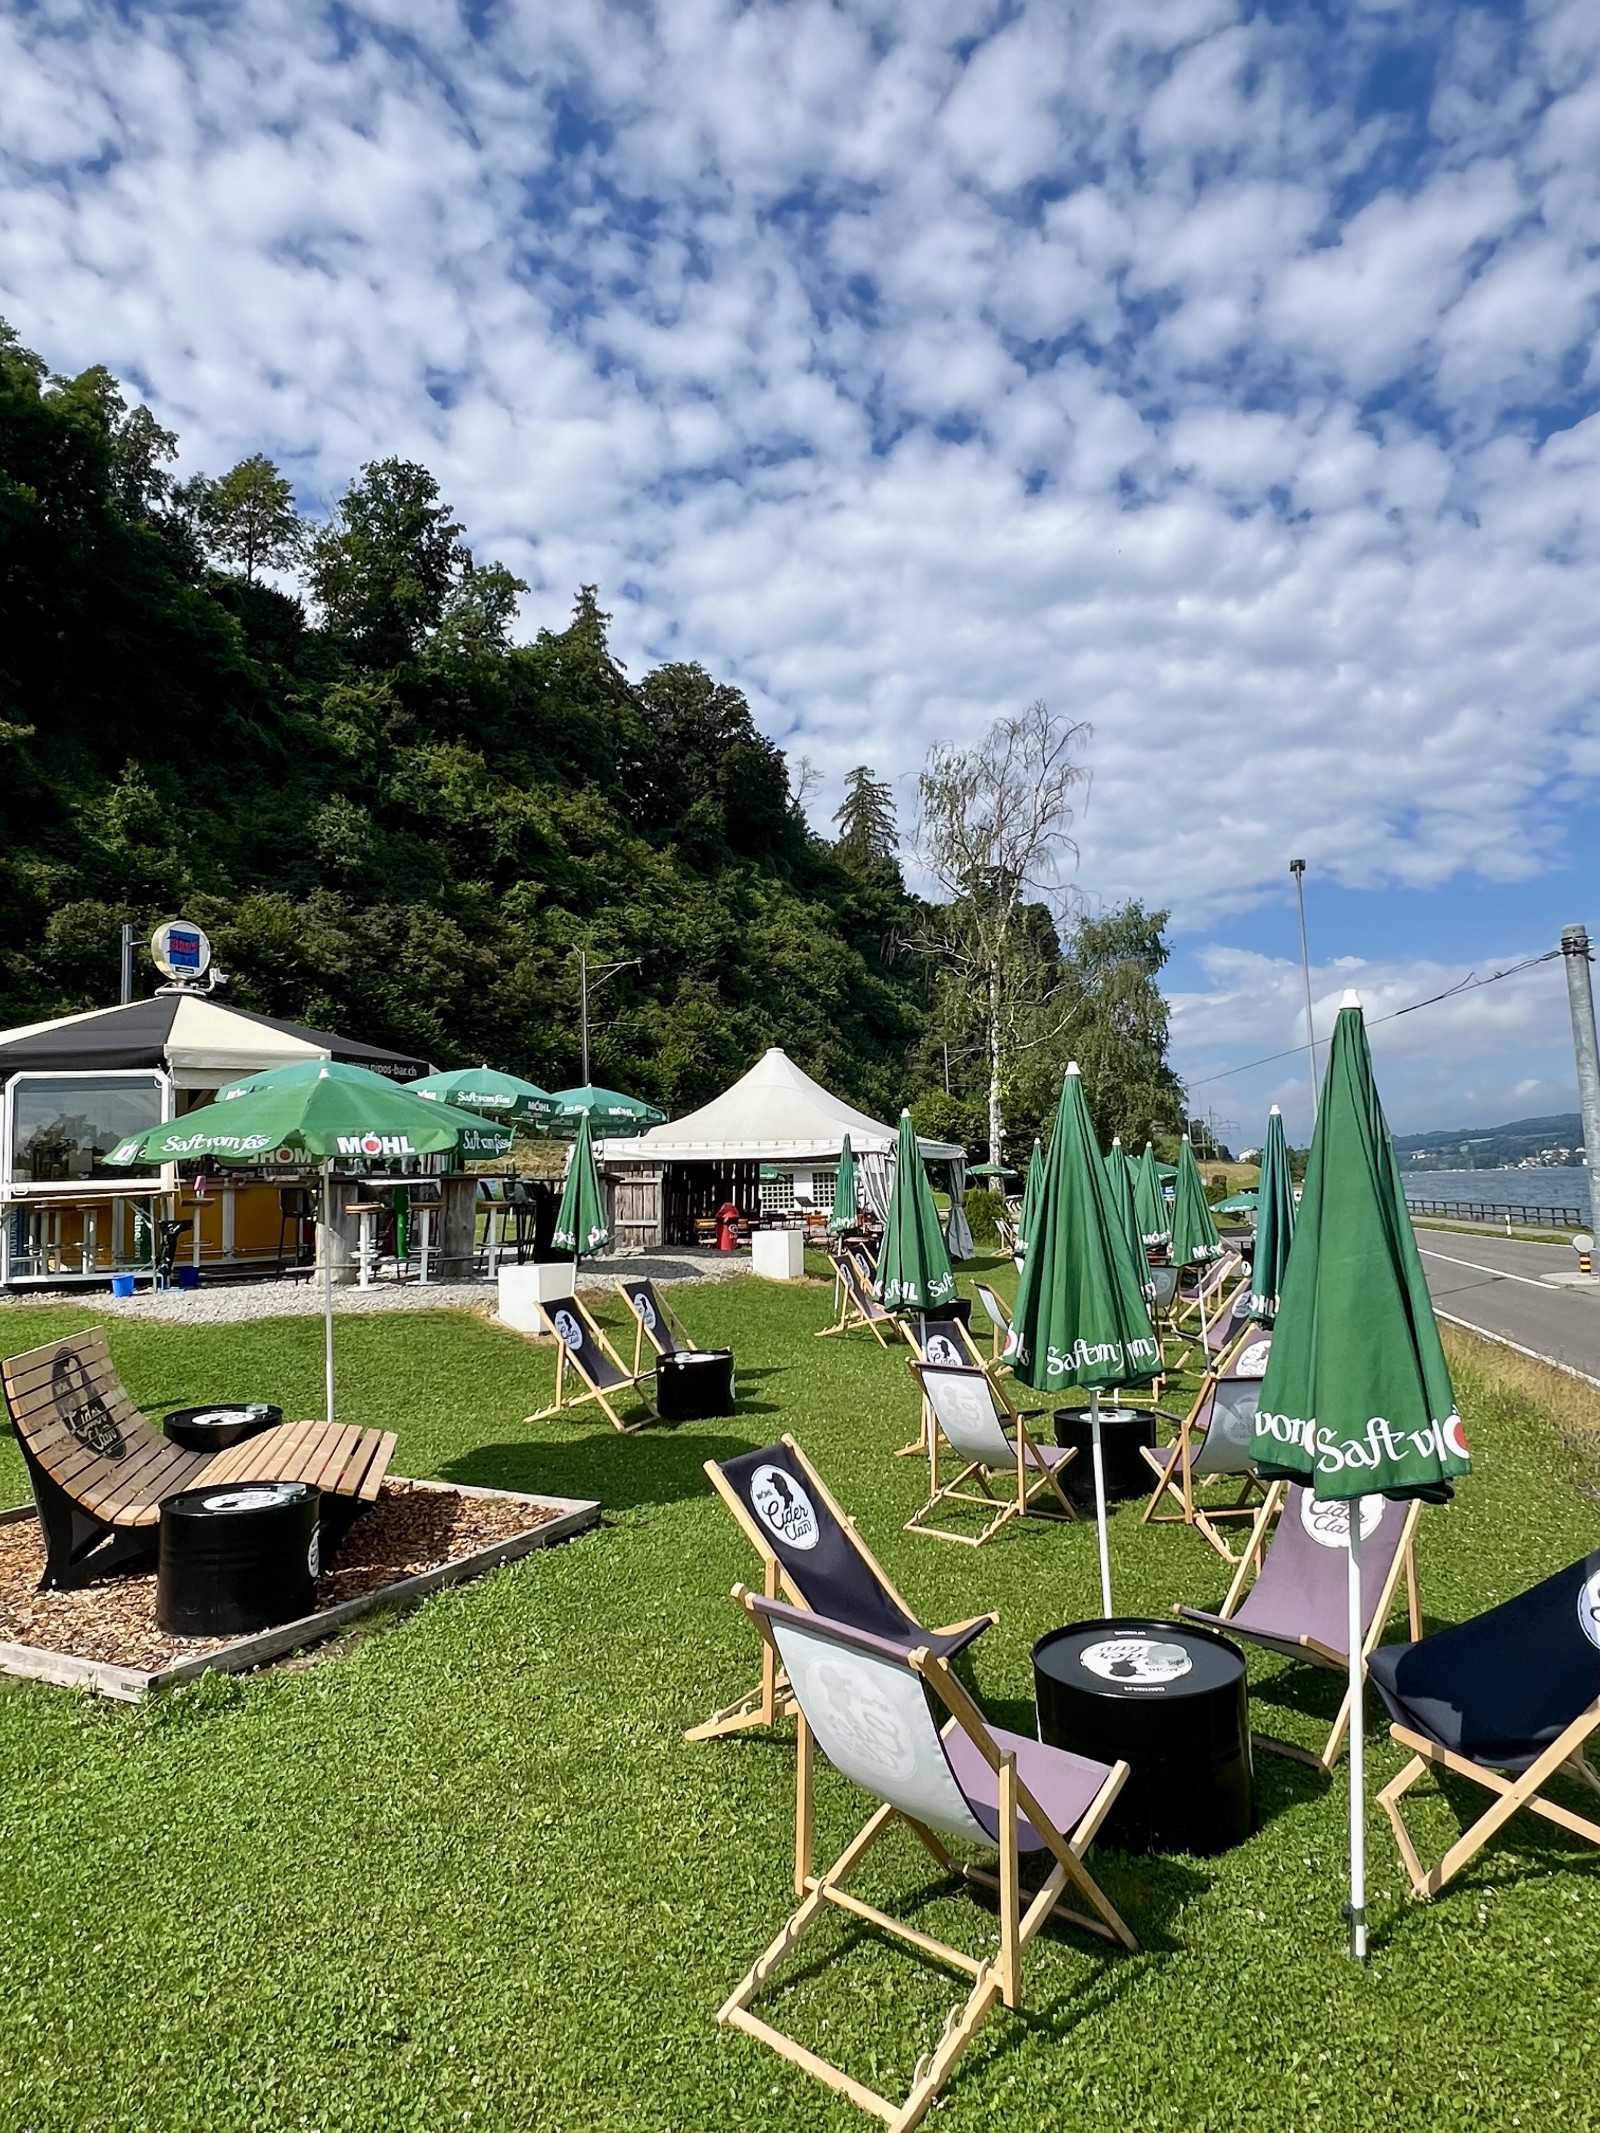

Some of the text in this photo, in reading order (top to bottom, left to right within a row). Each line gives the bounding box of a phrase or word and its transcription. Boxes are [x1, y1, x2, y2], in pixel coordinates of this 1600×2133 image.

[160, 1134, 208, 1152] Saft
[336, 1131, 415, 1154] MÖHL
[134, 1211, 145, 1259] eineken
[1316, 1416, 1409, 1474] Saft
[762, 1500, 809, 1531] Cider
[1313, 1515, 1351, 1534] Cla
[784, 1519, 812, 1541] Clan
